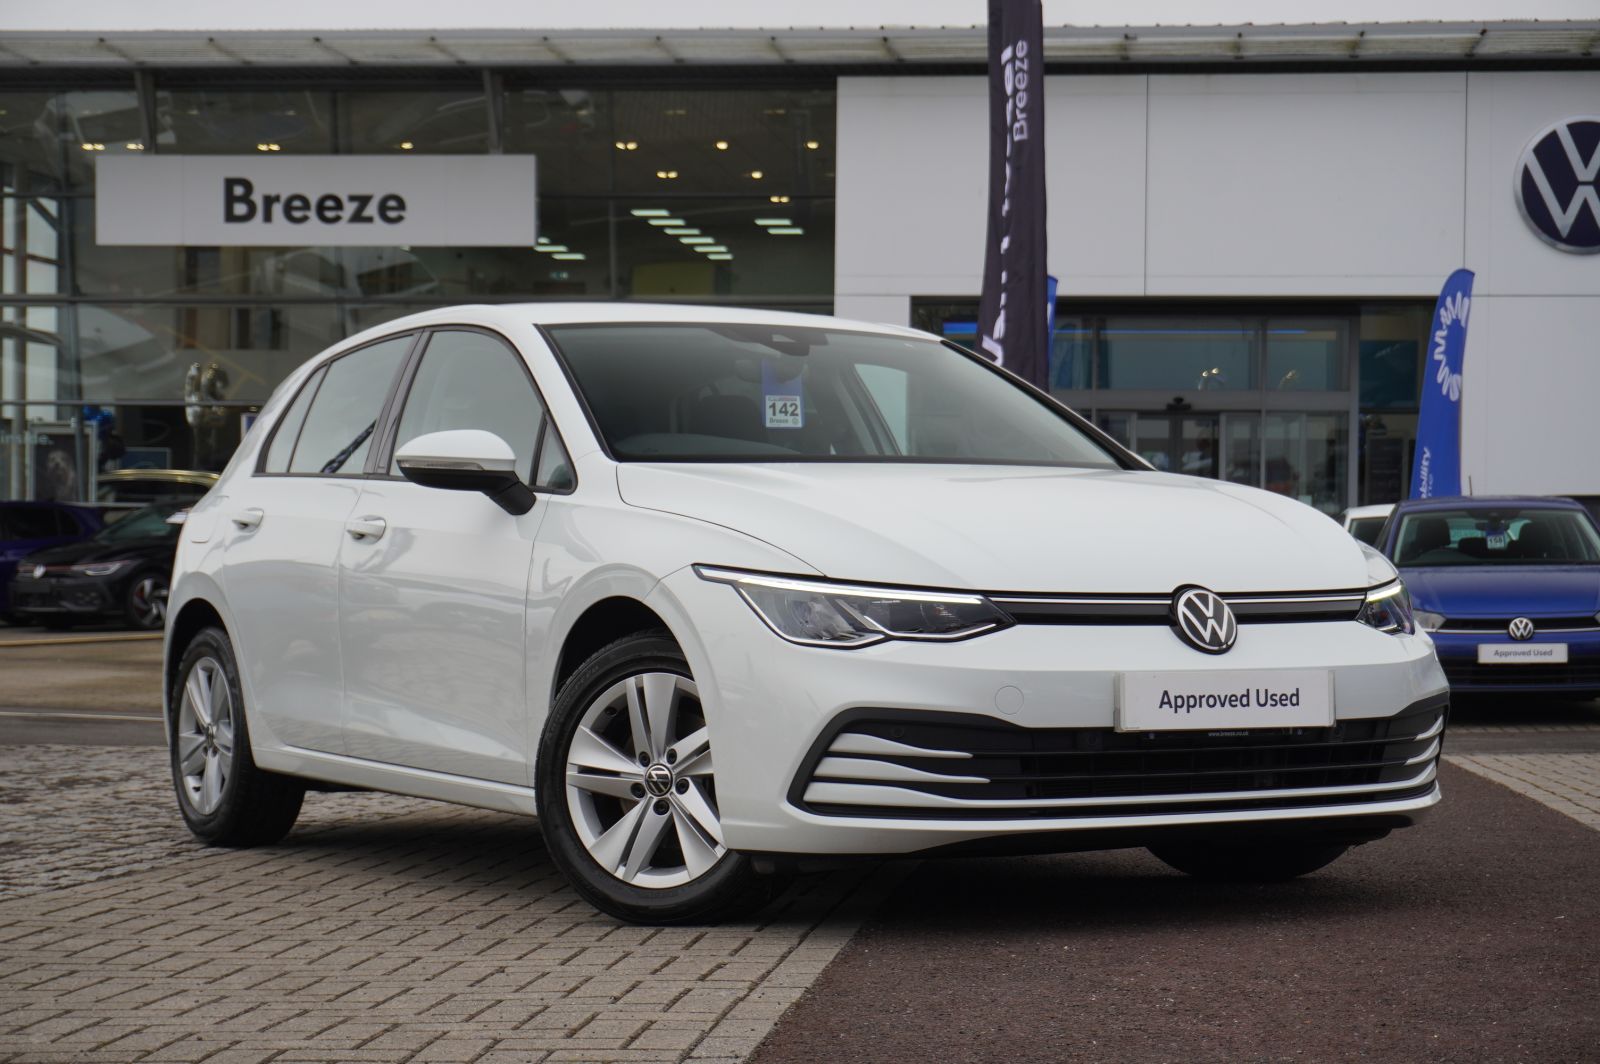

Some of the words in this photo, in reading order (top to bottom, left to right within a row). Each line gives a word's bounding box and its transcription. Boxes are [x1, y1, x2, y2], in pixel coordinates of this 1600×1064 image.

[1013, 40, 1029, 142] Breeze
[222, 176, 406, 225] Breeze
[769, 401, 799, 417] 142
[1494, 649, 1531, 658] Approved
[1533, 649, 1553, 657] Used
[1158, 688, 1250, 713] Approved
[1255, 687, 1300, 708] Used
